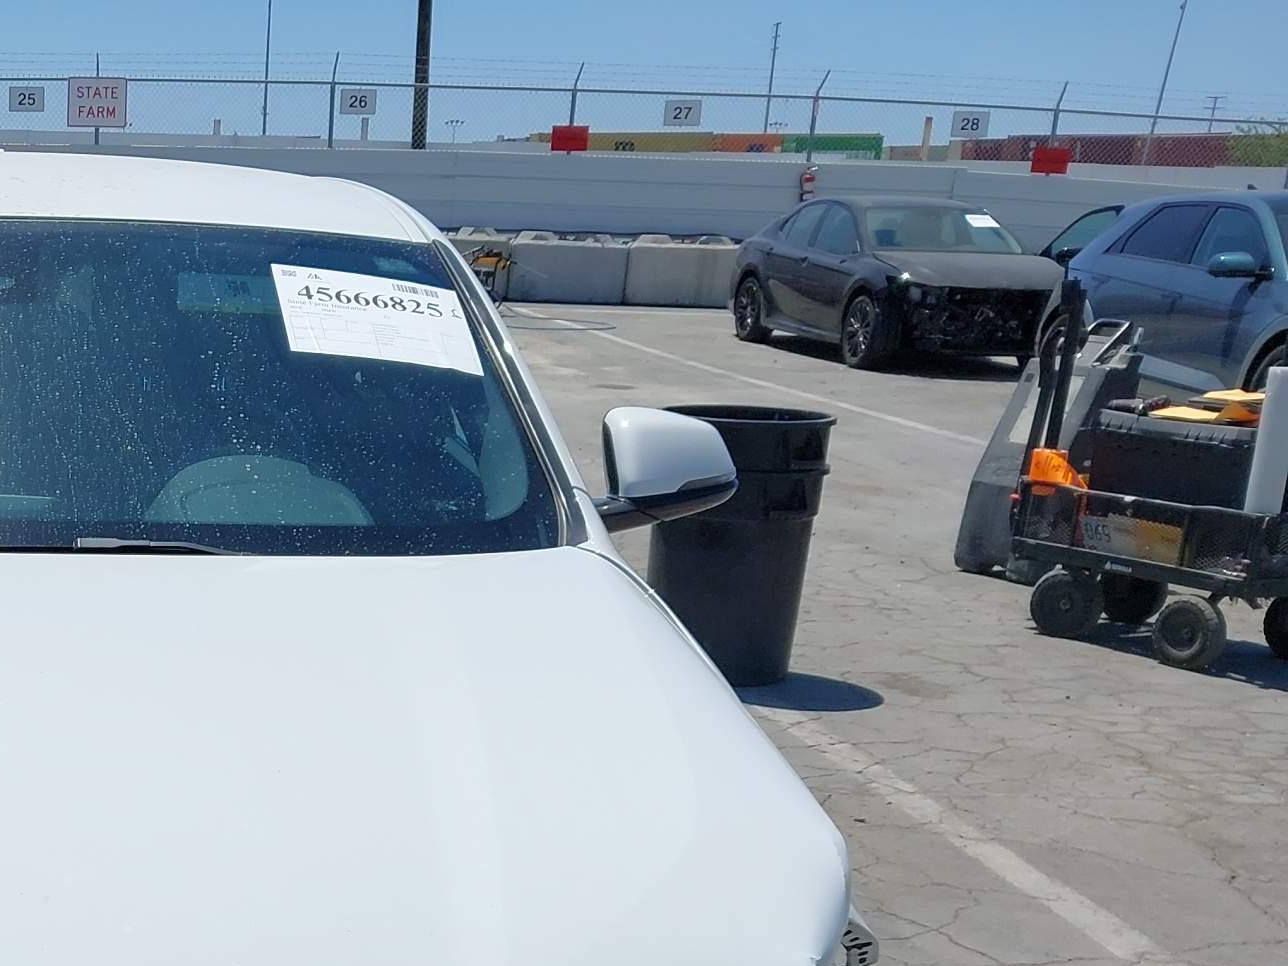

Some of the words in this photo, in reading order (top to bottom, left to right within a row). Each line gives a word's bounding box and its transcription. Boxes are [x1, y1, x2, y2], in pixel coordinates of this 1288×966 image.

[17, 92, 36, 106] 25
[76, 86, 119, 99] STATE
[348, 95, 368, 109] 26
[78, 105, 116, 119] FARM
[672, 106, 693, 120] 27
[960, 117, 980, 132] 28
[297, 284, 443, 318] 45666825
